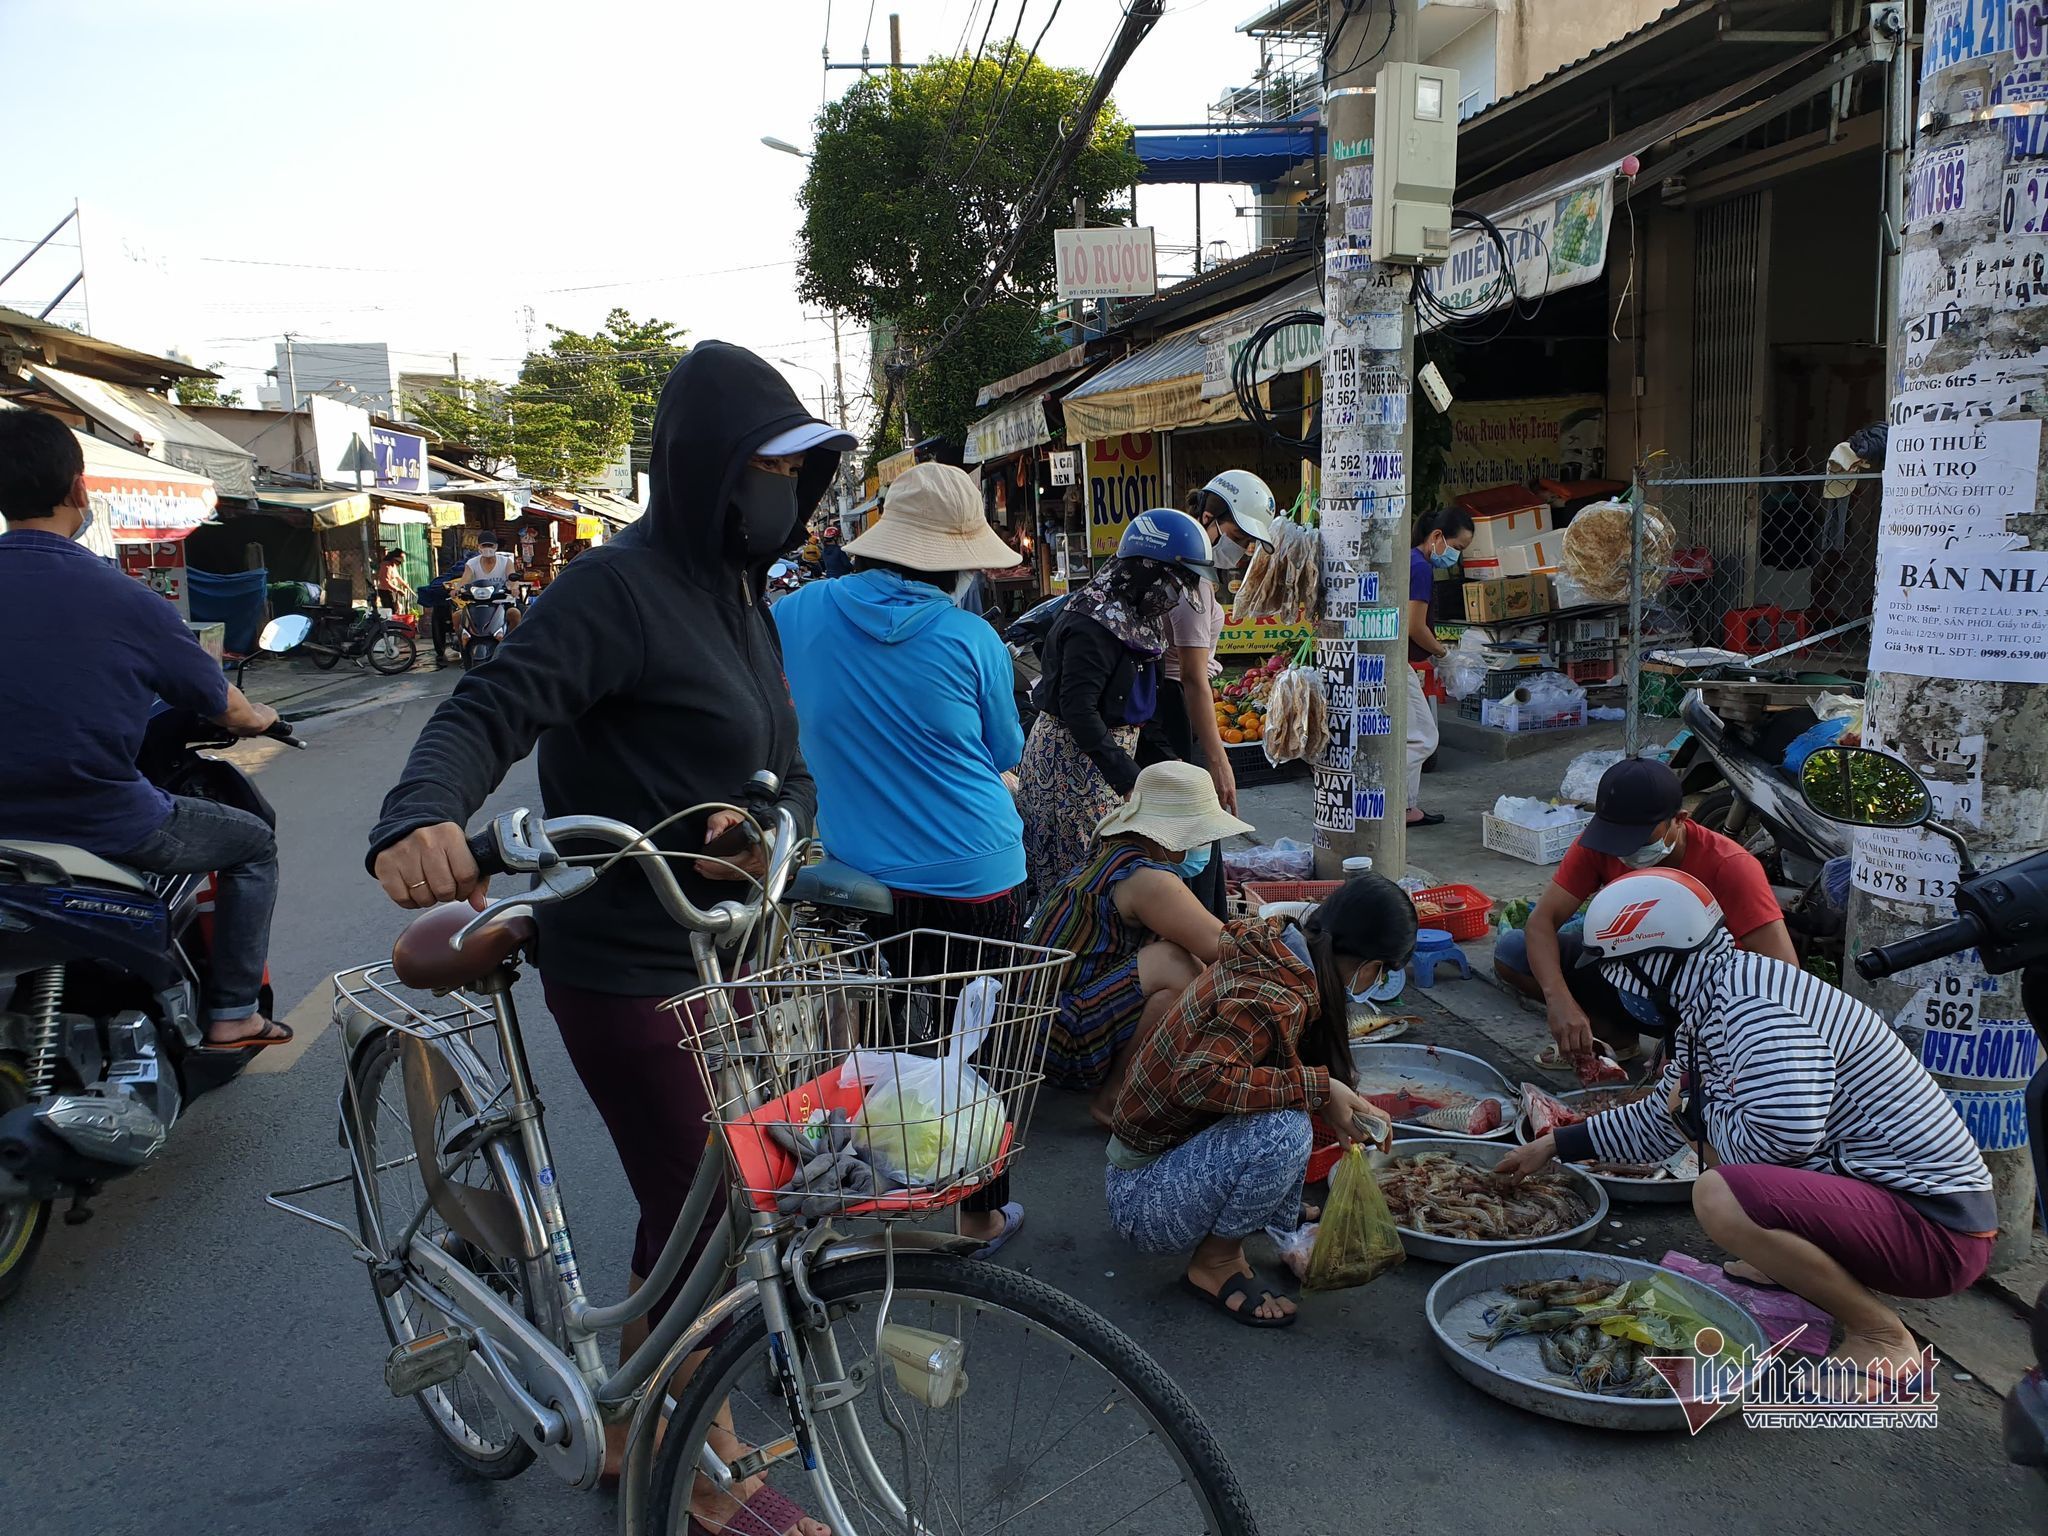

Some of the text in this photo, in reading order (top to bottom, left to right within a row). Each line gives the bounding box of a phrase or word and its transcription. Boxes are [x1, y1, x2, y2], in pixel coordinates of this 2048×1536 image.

[1507, 214, 1549, 265] TÂY
[1062, 233, 1149, 292] LÒ RƯỢU
[1338, 372, 1356, 389] 161
[1366, 374, 1385, 395] 0985
[1945, 374, 1977, 388] 6tr5
[1337, 389, 1356, 407] 562
[1896, 438, 1925, 452] CHO
[1340, 454, 1361, 471] 562
[1898, 459, 1977, 479] NHÀ TRỌ
[1330, 500, 1360, 511] VAY
[1898, 558, 1969, 591] BÁN
[1336, 601, 1357, 618] 345
[2016, 609, 2022, 617] 3
[1884, 641, 1902, 651] Giá
[1927, 645, 1945, 656] TL.
[2023, 635, 2042, 645] Q12
[1324, 649, 1354, 669] VAY
[1323, 773, 1352, 792] VAY
[1873, 869, 1908, 893] 878
[1917, 878, 1959, 898] 132
[1924, 1001, 1974, 1031] 562
[1923, 1027, 2038, 1079] 0973.600.700
